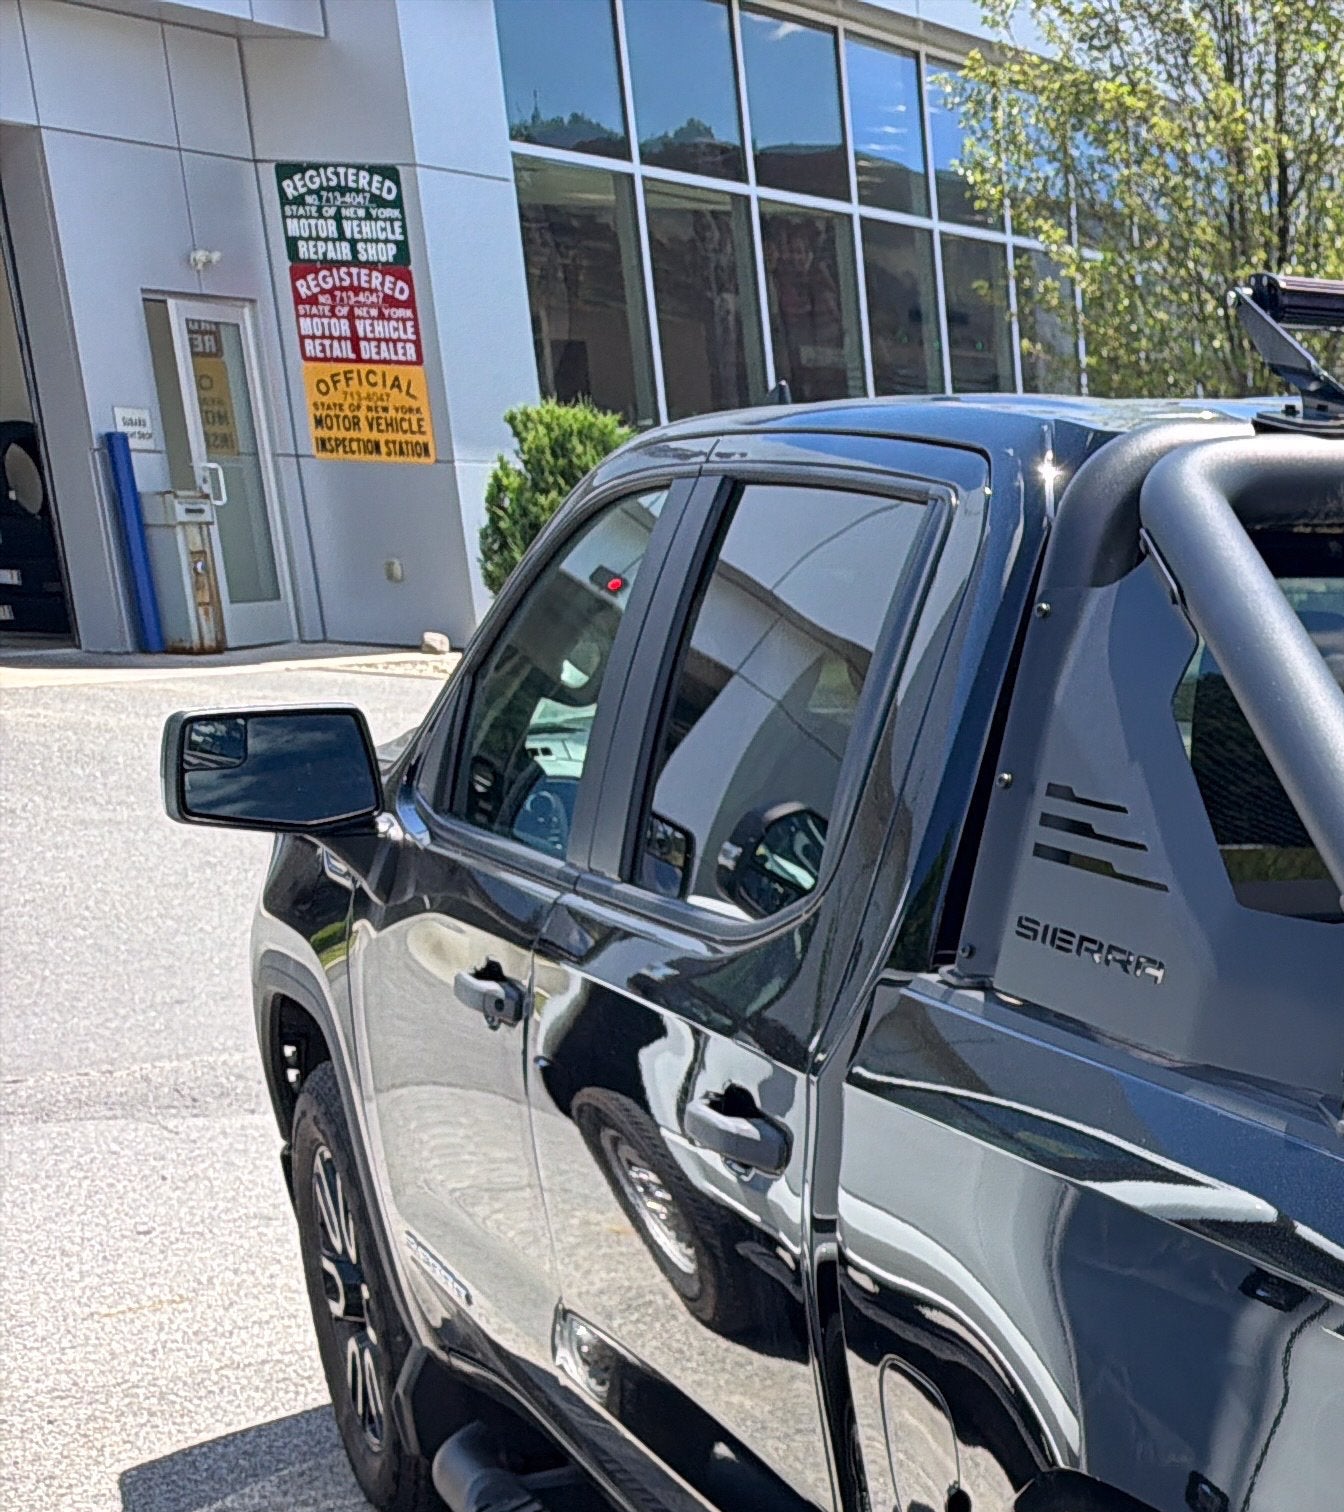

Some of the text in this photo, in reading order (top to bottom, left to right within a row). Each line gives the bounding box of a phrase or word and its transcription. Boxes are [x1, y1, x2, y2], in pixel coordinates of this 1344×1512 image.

[282, 167, 398, 200] REGISTERED
[284, 205, 402, 219] STATE OF NEW YORK
[286, 218, 405, 241] MOTOR VEHICLE
[297, 240, 397, 263] REPAIR SHOP
[295, 267, 410, 301] REGISTERED
[298, 305, 414, 319] STATE OF NEW YORK
[299, 317, 417, 341] MOTOR VEHICLE
[304, 339, 417, 362] RETAIL DEALER
[315, 369, 418, 400] OFFICIAL
[312, 401, 422, 415] STATE OF NEW YORK
[313, 413, 426, 435] MOTOR VEHICLE
[314, 436, 431, 458] INSPECTION STATION
[1015, 915, 1166, 984] SIERRA
